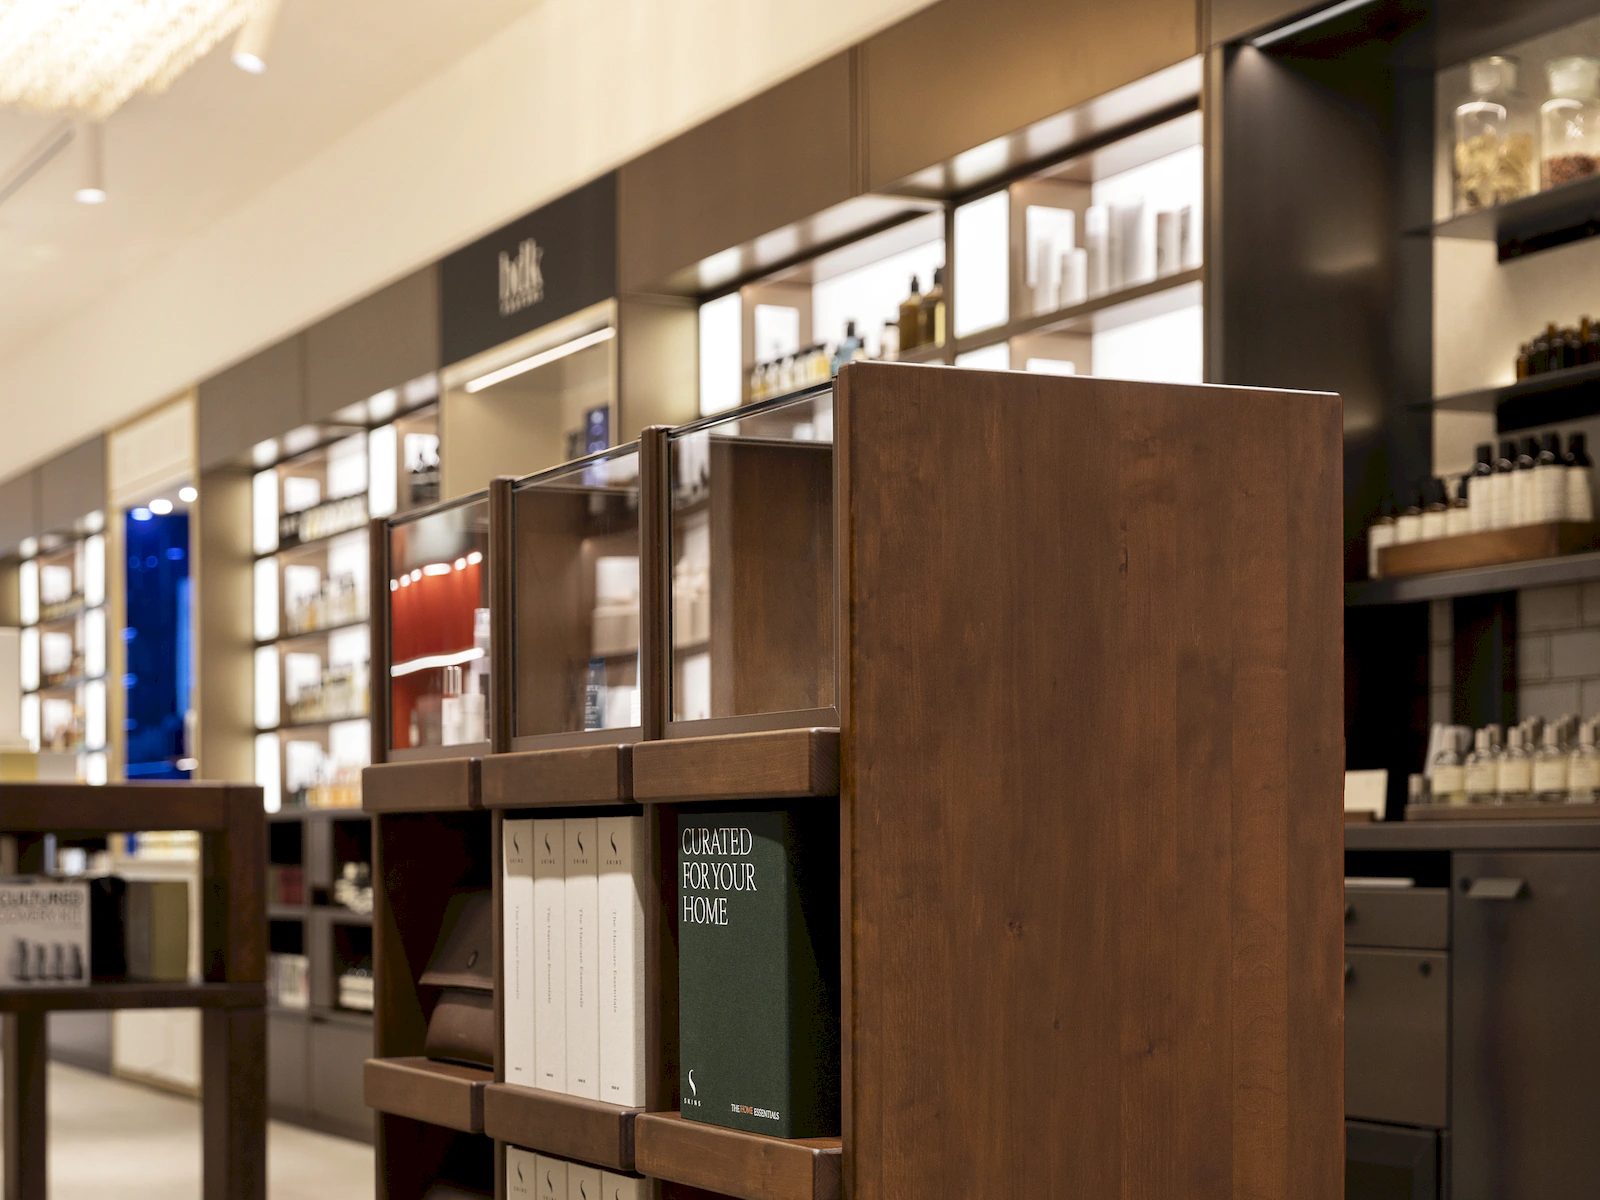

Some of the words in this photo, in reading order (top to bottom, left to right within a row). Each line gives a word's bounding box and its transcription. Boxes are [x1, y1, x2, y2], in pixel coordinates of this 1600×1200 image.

[682, 827, 753, 856] CURATED
[683, 862, 710, 889] FOR
[710, 862, 757, 891] YOUR
[683, 896, 728, 926] HOME
[684, 1098, 702, 1107] SKINS
[731, 1103, 740, 1113] THE
[740, 1105, 753, 1115] HOME
[754, 1107, 780, 1120] ESSENTIALS
